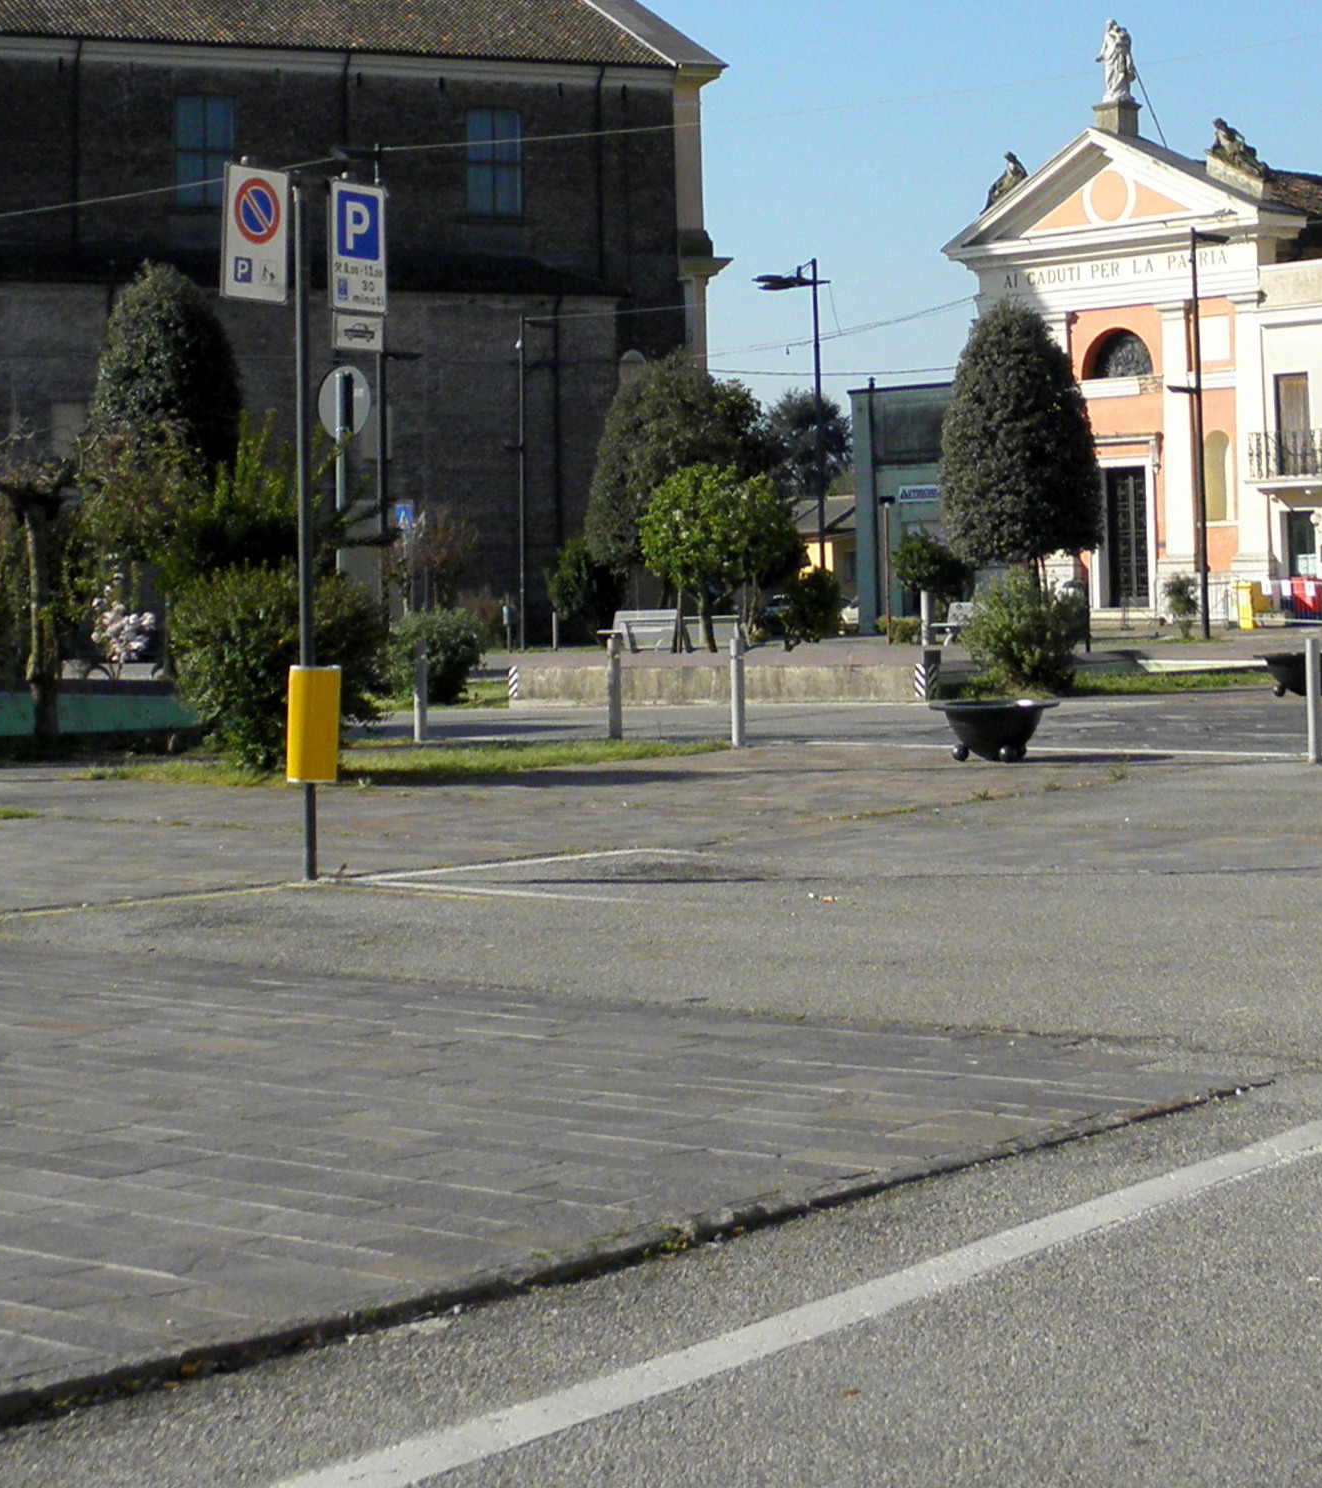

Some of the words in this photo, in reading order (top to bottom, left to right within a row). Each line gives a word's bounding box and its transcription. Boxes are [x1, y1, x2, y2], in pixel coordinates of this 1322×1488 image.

[346, 201, 370, 250] P
[237, 261, 249, 279] P
[1003, 273, 1018, 289] AI
[1027, 266, 1081, 287] CADUTI
[1091, 262, 1120, 279] PER
[1133, 258, 1154, 274] LA
[1167, 250, 1228, 271] PARIA
[361, 280, 375, 292] 30
